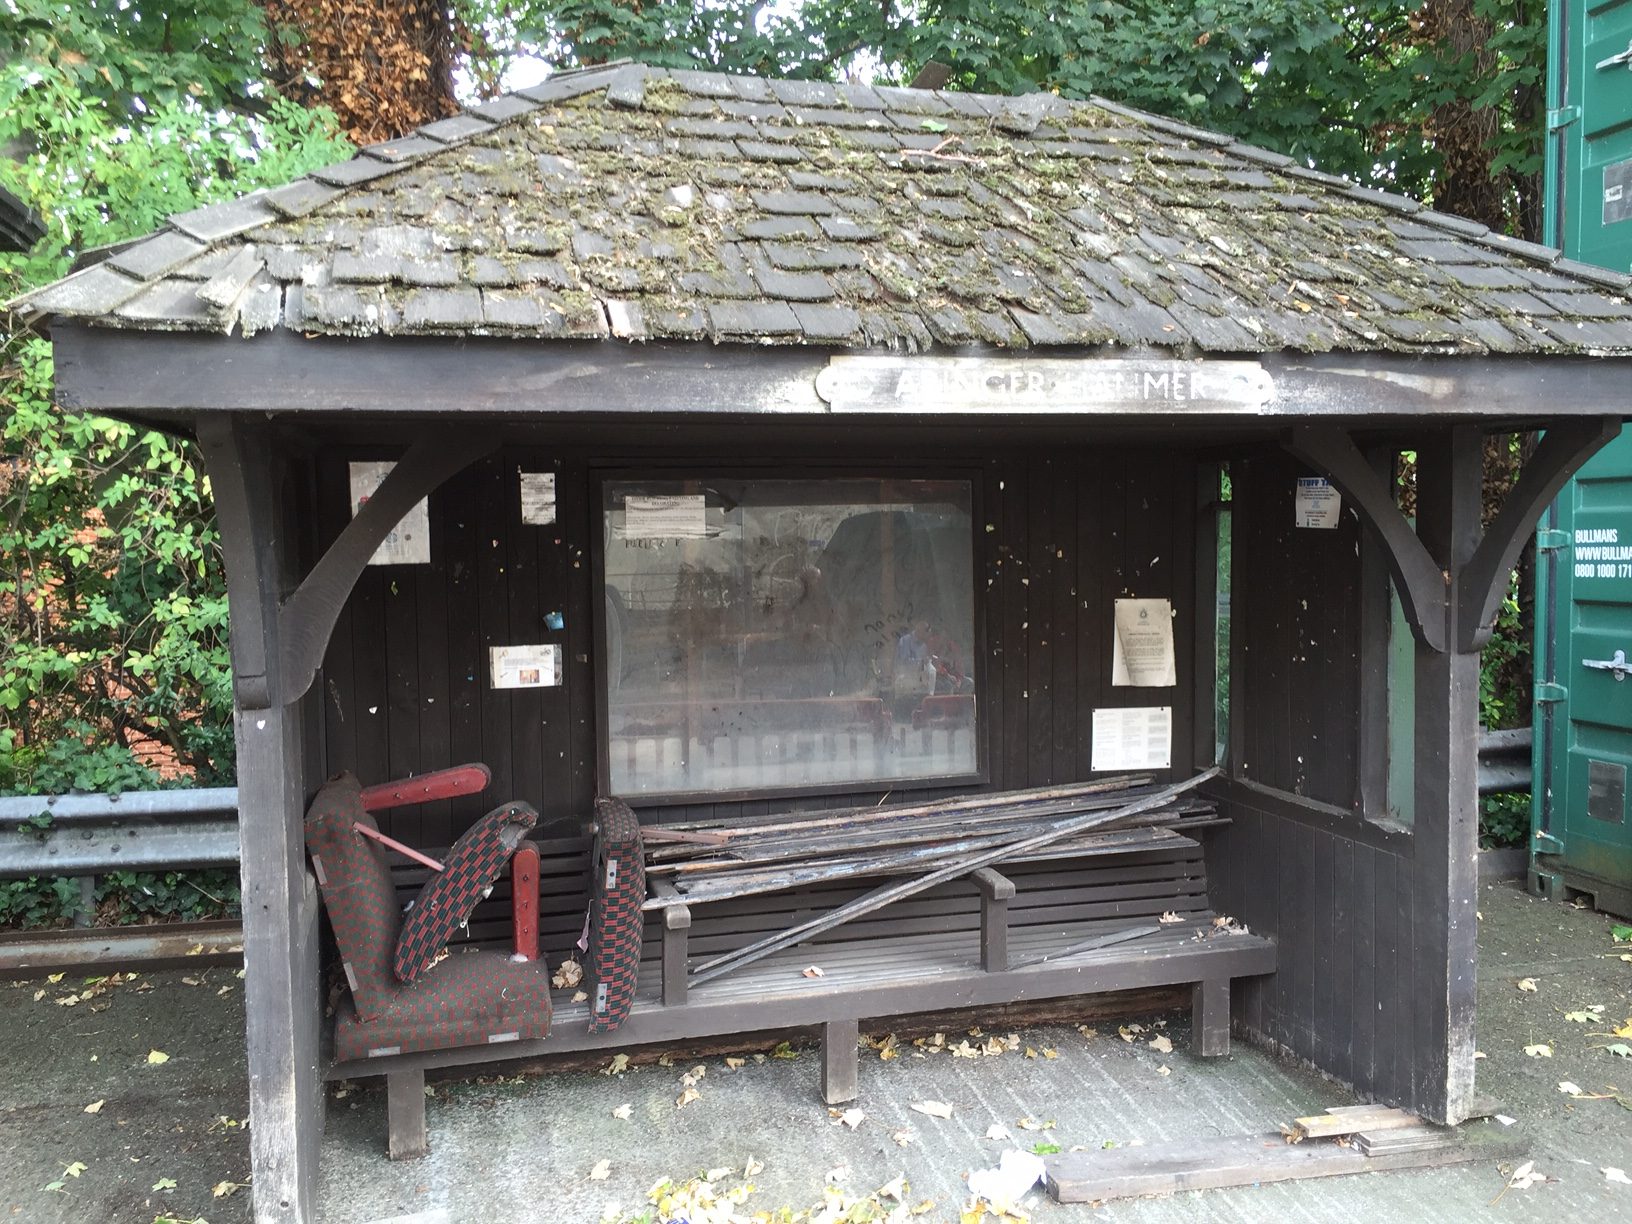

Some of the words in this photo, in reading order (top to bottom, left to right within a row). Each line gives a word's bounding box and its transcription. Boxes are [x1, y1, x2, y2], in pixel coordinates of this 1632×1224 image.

[1575, 529, 1618, 543] BULLMANS
[1575, 563, 1595, 578] 0800
[1597, 563, 1616, 578] 1000
[1618, 563, 1632, 578] 171
